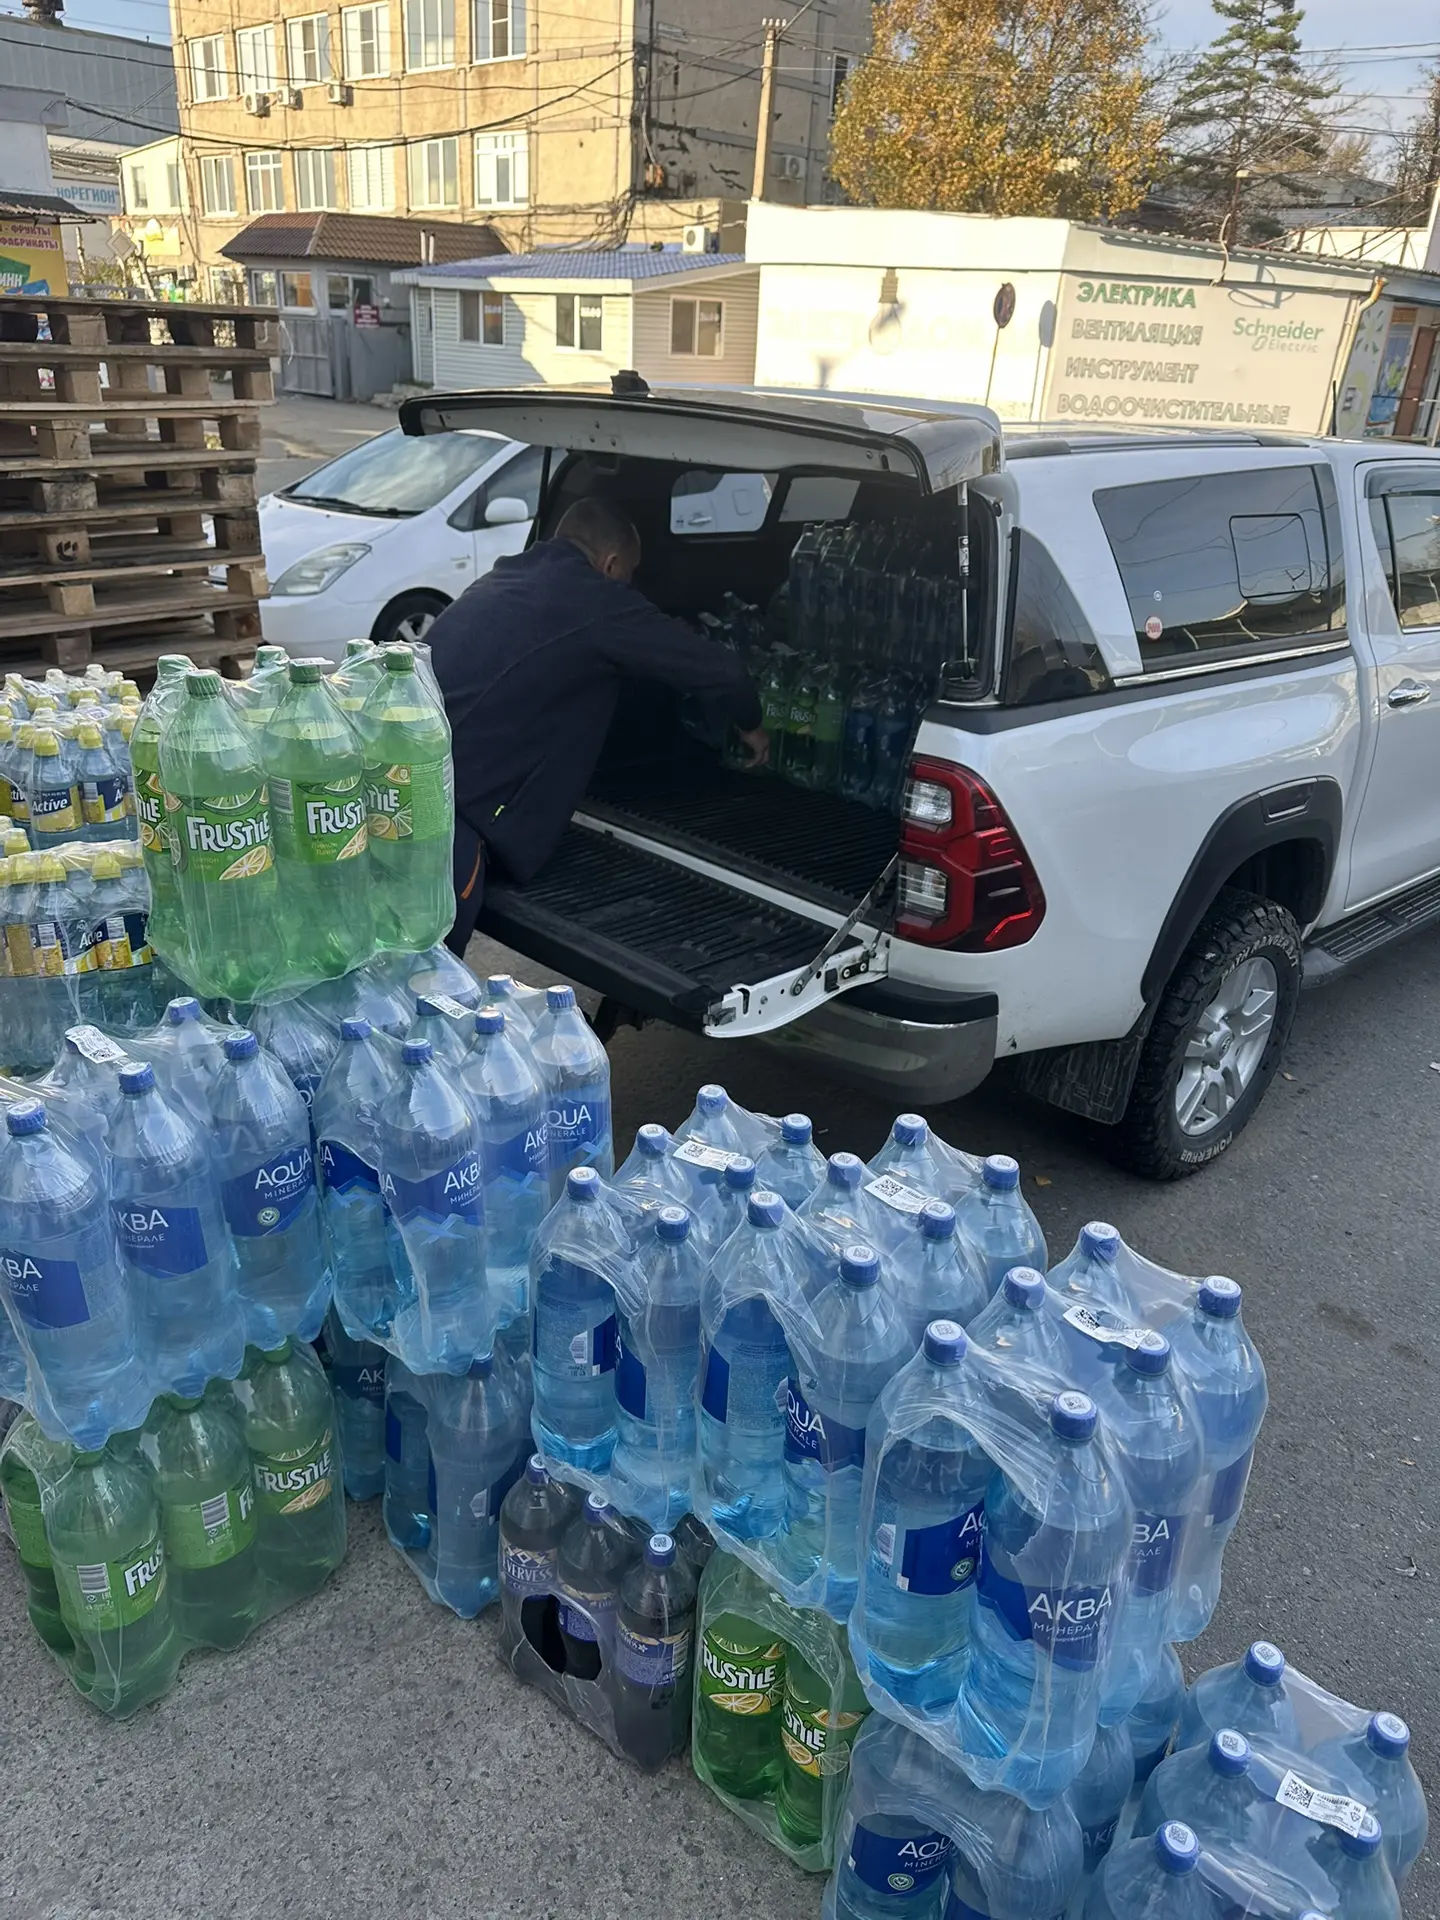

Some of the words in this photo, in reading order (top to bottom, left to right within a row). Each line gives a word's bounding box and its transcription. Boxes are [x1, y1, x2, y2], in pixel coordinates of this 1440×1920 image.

[1076, 281, 1197, 309] ЭЛЕКТРИКА
[1071, 318, 1204, 347] ВЕНТИЛЯЦИЯ
[1232, 317, 1325, 341] Schneider
[1267, 338, 1320, 353] Electric
[1065, 356, 1200, 384] ИНСТРУМЕНТ
[1057, 393, 1291, 425] ВОДООЧИСТИТЕЛЬНЫЕ
[254, 1147, 312, 1190] AQUA
[253, 1449, 332, 1493] FRUSTYLE
[1027, 1587, 1112, 1624] АКВА
[703, 1640, 777, 1690] RUSTYLE
